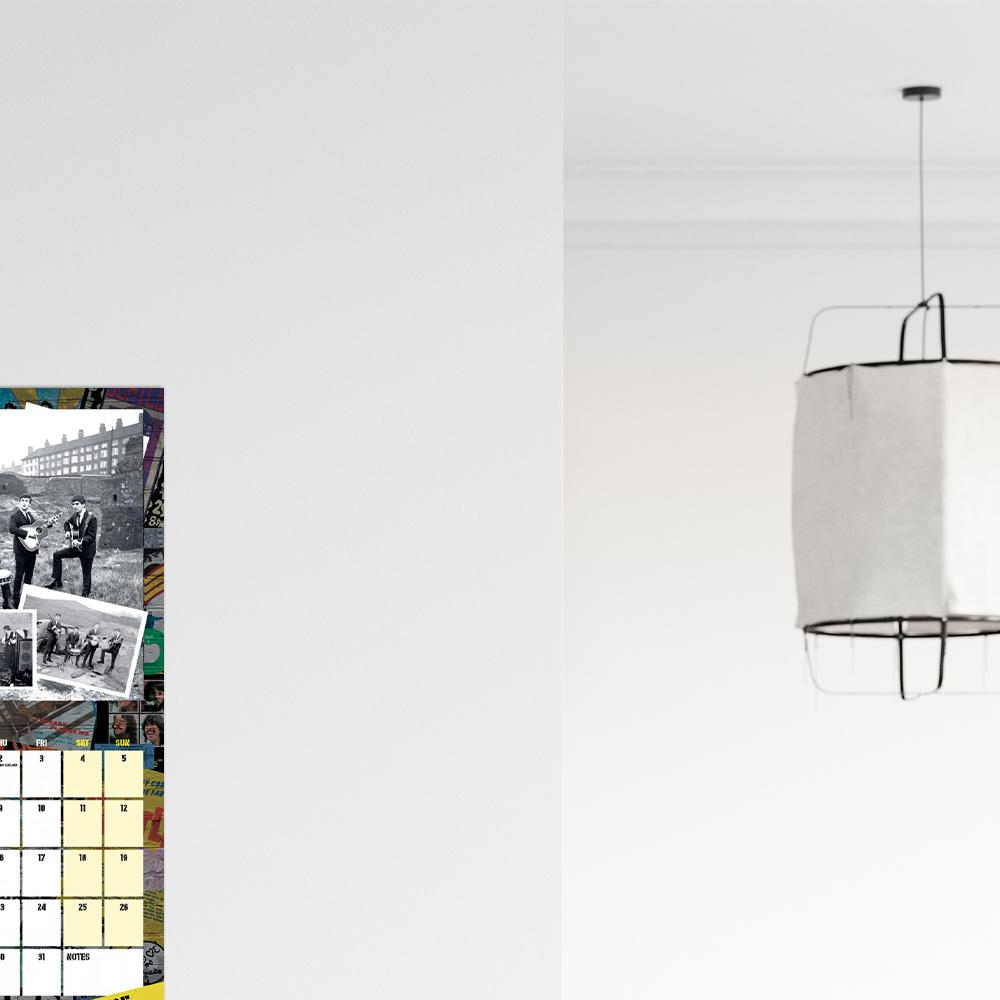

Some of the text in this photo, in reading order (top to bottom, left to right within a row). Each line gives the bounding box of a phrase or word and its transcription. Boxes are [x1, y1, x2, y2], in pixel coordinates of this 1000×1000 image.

[36, 738, 48, 747] FRI
[115, 738, 131, 747] SUN
[39, 754, 44, 763] 3
[80, 754, 86, 763] 4
[121, 754, 127, 763] 5
[37, 804, 46, 813] 10
[79, 804, 86, 813] 11
[120, 804, 128, 813] 12
[37, 853, 46, 862] 17
[78, 853, 87, 862] 18
[119, 853, 128, 862] 19
[37, 903, 46, 912] 24
[78, 903, 88, 912] 25
[119, 903, 129, 912] 26
[37, 952, 46, 961] 31
[66, 952, 91, 961] NOTES
